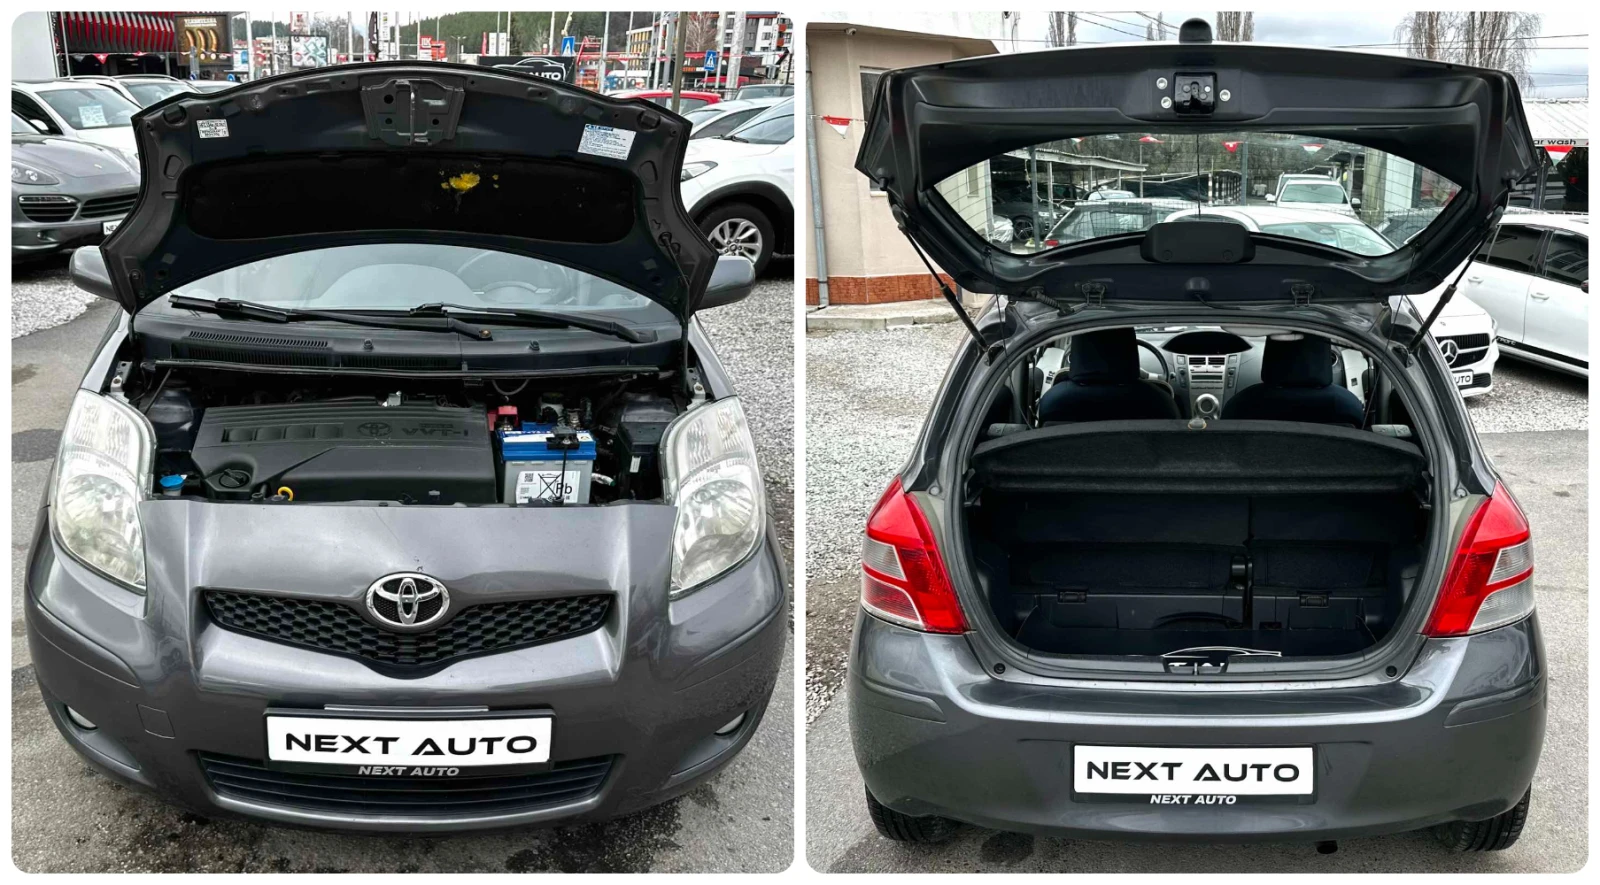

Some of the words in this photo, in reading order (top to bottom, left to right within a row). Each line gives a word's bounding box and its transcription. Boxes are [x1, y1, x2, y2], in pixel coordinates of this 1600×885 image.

[1454, 375, 1471, 383] UTO
[286, 733, 399, 755] NEXT
[411, 735, 538, 756] AUTO
[358, 766, 407, 776] NEXT
[410, 767, 459, 777] AUTO
[1087, 761, 1183, 781] NEXT
[1193, 763, 1300, 782] AUTO
[1150, 795, 1192, 805] NEXT
[1194, 795, 1236, 805] AUTO
